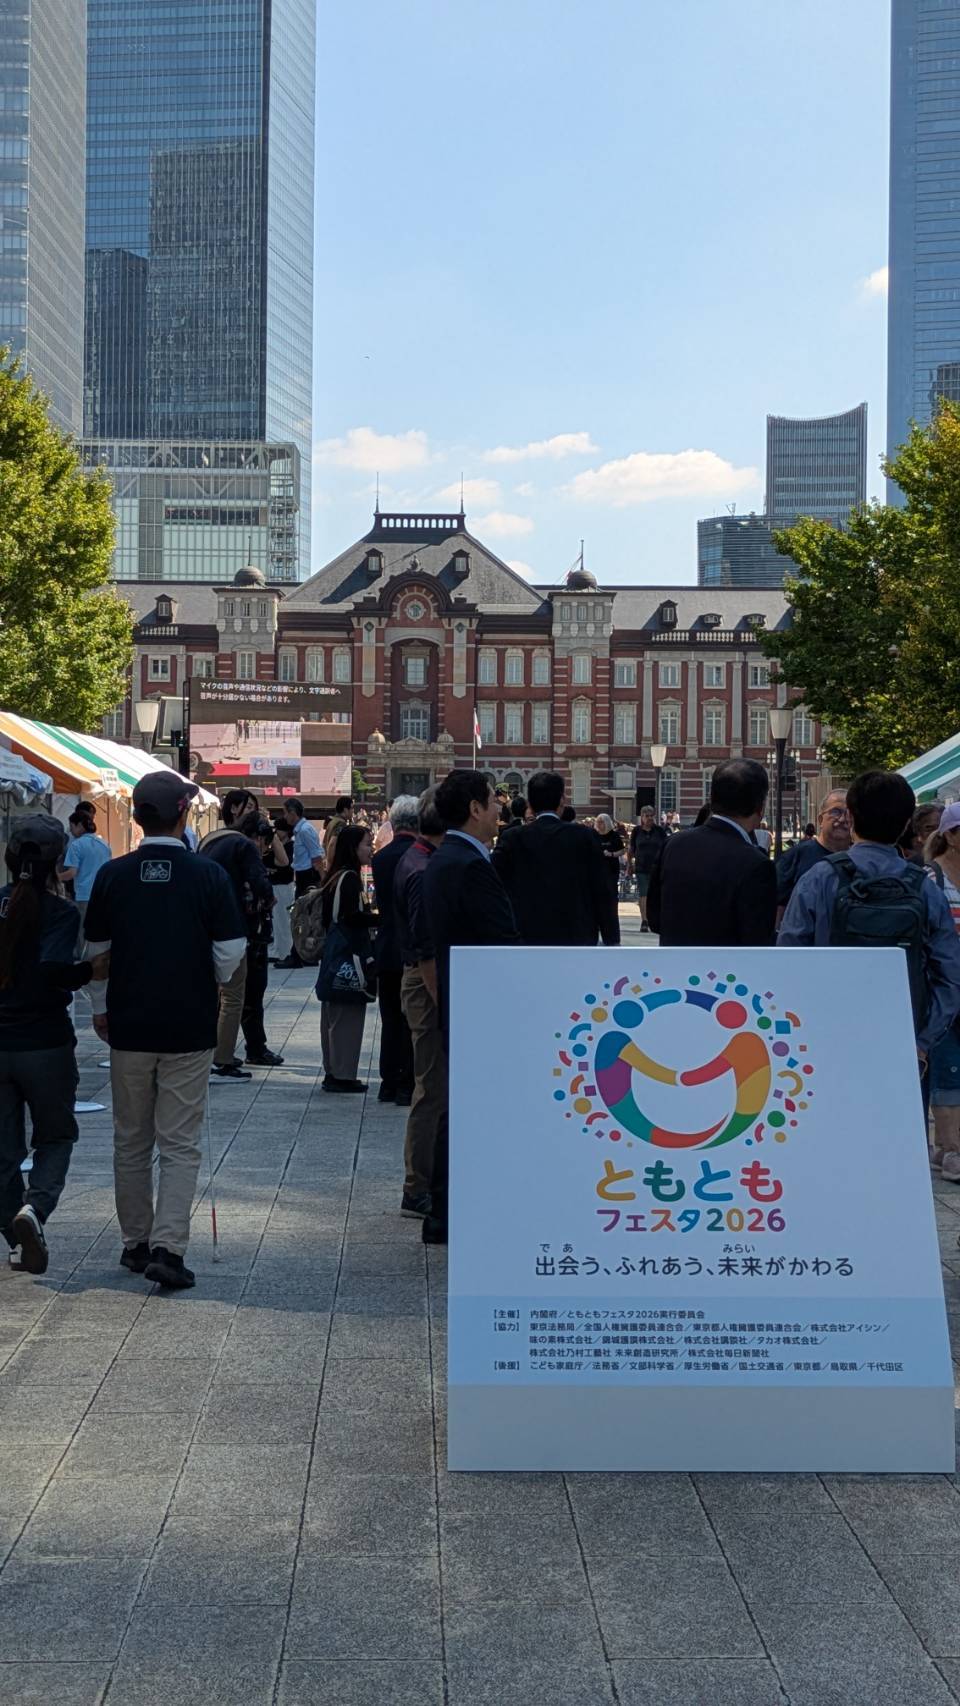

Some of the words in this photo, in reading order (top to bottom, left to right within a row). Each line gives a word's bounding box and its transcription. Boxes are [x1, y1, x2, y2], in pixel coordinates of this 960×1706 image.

[596, 1160, 783, 1202] ともとも
[539, 1244, 551, 1253] で
[563, 1244, 574, 1253] あ
[723, 1244, 756, 1253] みらい
[535, 1256, 854, 1276] 出会う、ふれあう、未来がかわる
